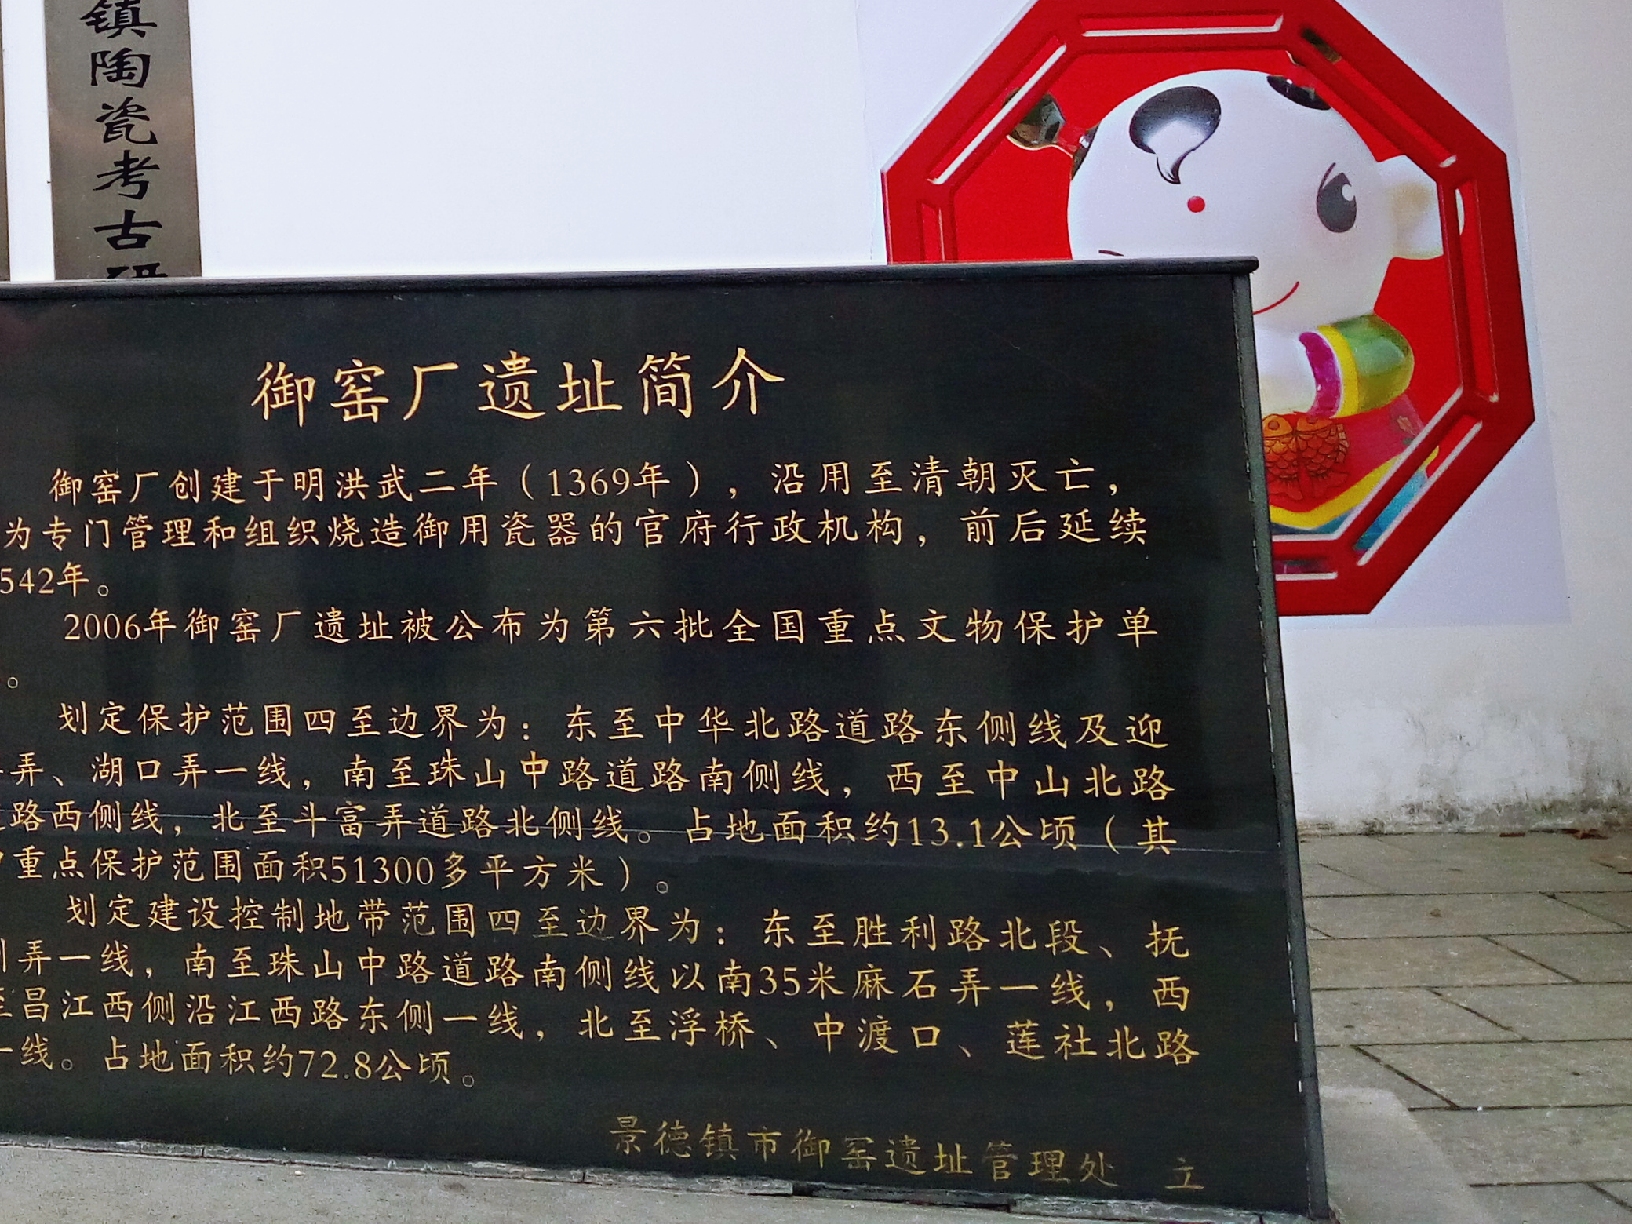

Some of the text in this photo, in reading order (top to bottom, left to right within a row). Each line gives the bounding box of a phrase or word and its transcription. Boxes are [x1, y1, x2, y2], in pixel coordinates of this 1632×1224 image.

[251, 346, 786, 428] 御窑厂遗址简介
[63, 605, 1159, 648] 2006年御窑厂遗址被公布为第六批全国重点文物保护单
[609, 1115, 1205, 1190] 景德镇市御窑遗址管理处 立
